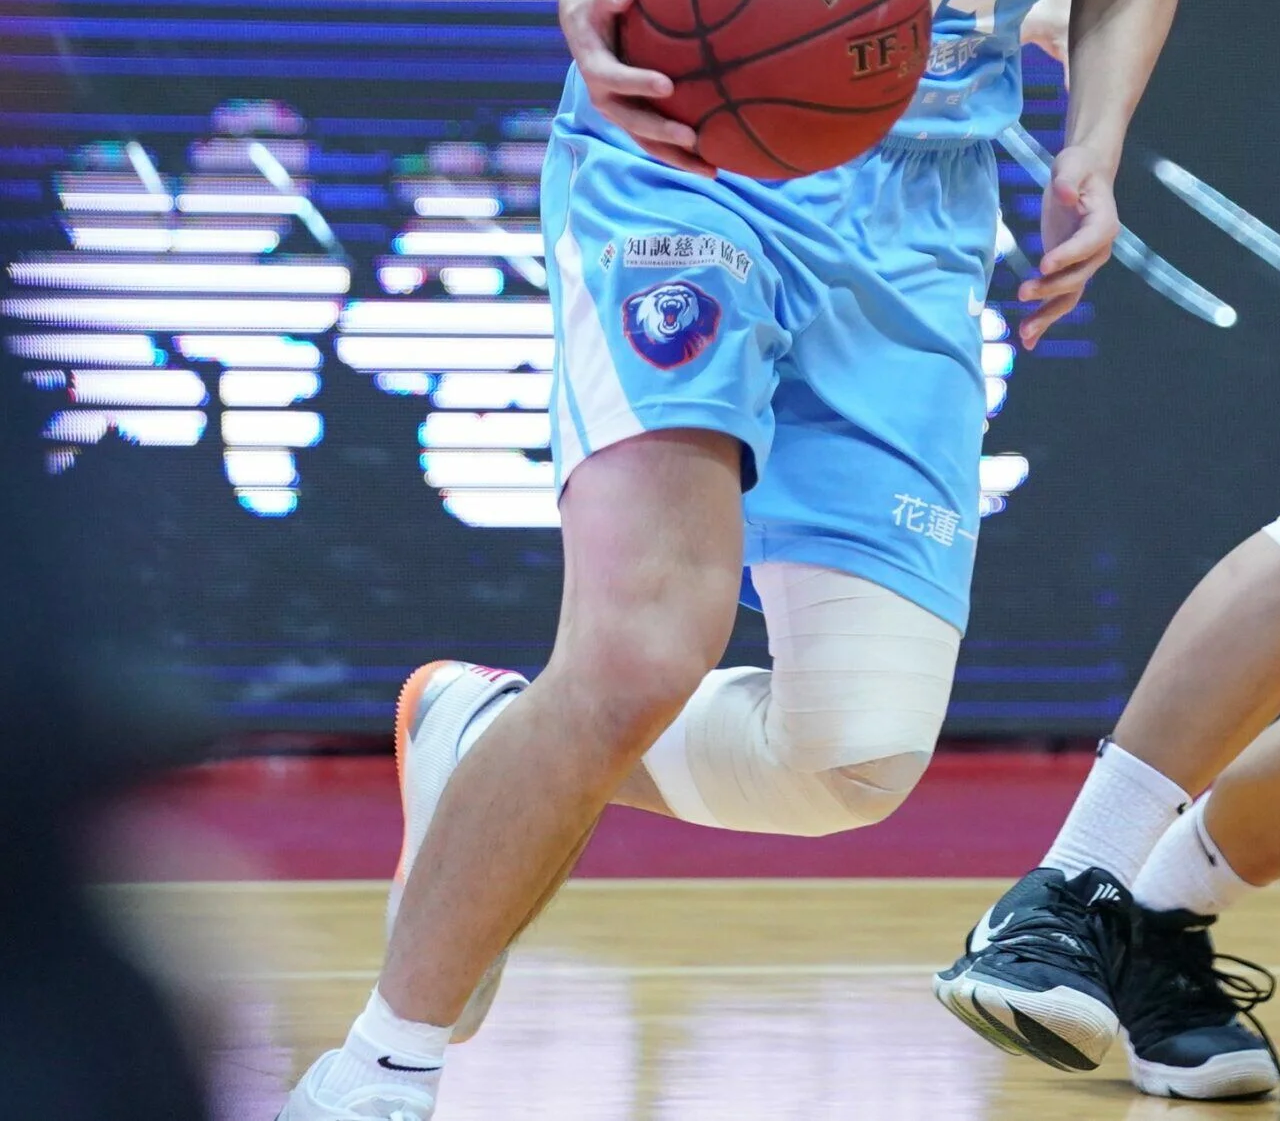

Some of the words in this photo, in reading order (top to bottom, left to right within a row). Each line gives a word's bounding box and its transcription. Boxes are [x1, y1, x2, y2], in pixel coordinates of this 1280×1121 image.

[627, 236, 750, 274] 知誠慈善協會
